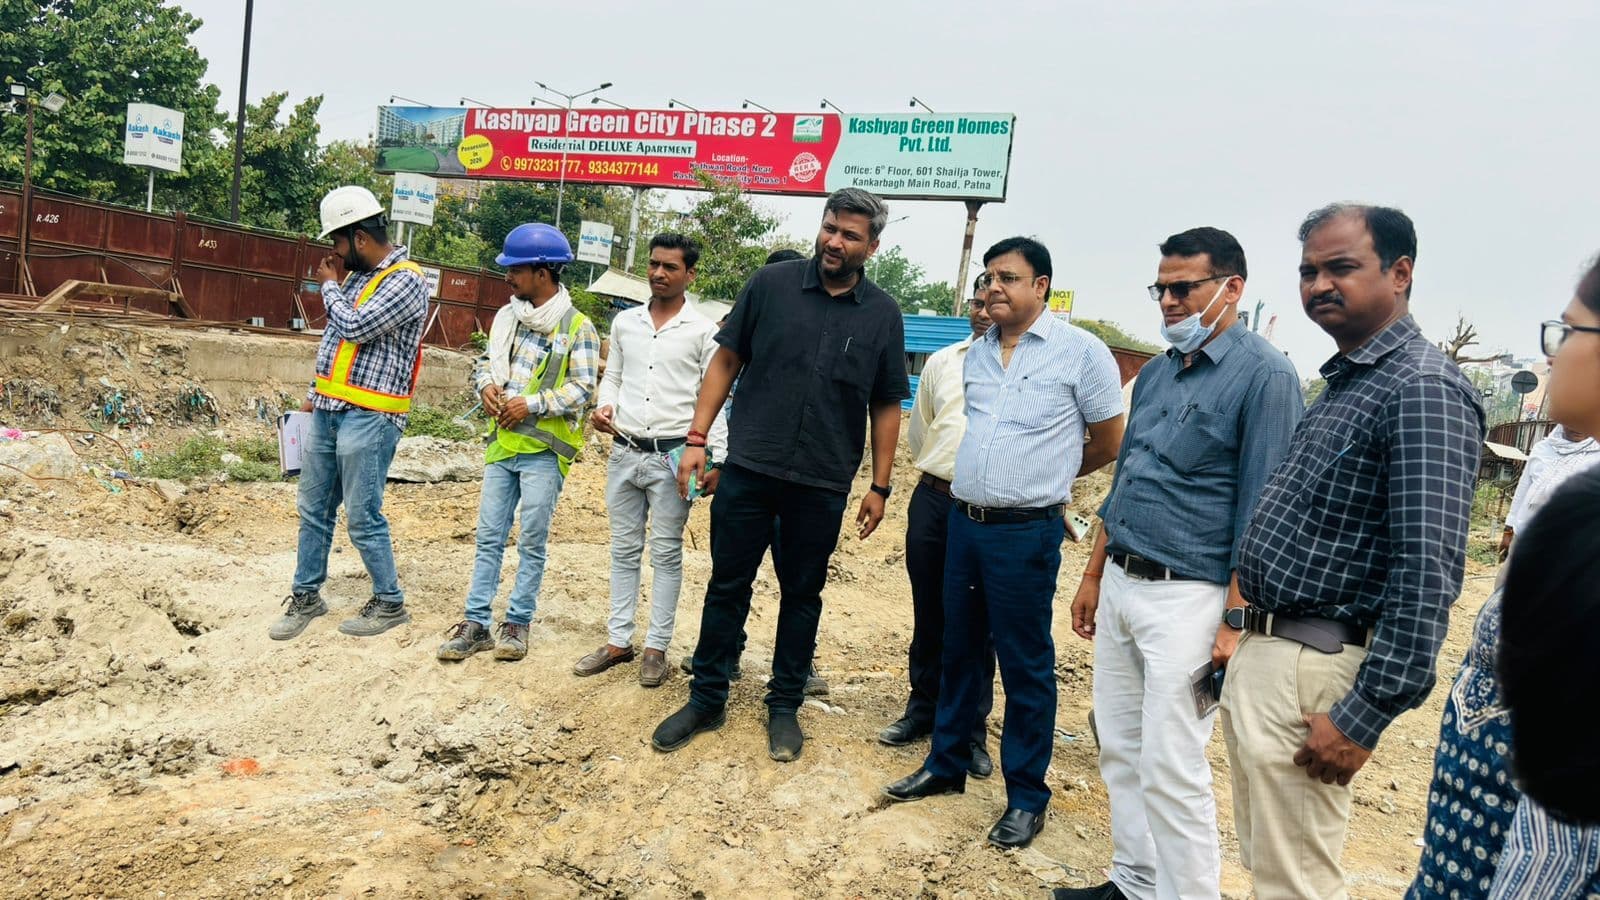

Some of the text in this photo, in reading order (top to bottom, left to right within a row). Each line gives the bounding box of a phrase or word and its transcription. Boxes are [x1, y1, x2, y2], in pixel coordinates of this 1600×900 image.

[475, 109, 777, 137] Kashyap Green City Phase 2
[848, 117, 1009, 135] Kashyap Green Homes
[589, 140, 633, 152] DELUXE
[899, 136, 952, 152] Pvt. Ltd.
[588, 161, 659, 176] 9334377144
[844, 165, 872, 175] Office:
[916, 166, 933, 176] 601
[936, 166, 969, 178] Shailja
[972, 167, 1003, 179] Tower,
[852, 177, 905, 189] Kankarbagh
[907, 178, 930, 188] Main
[963, 179, 991, 190] Patna
